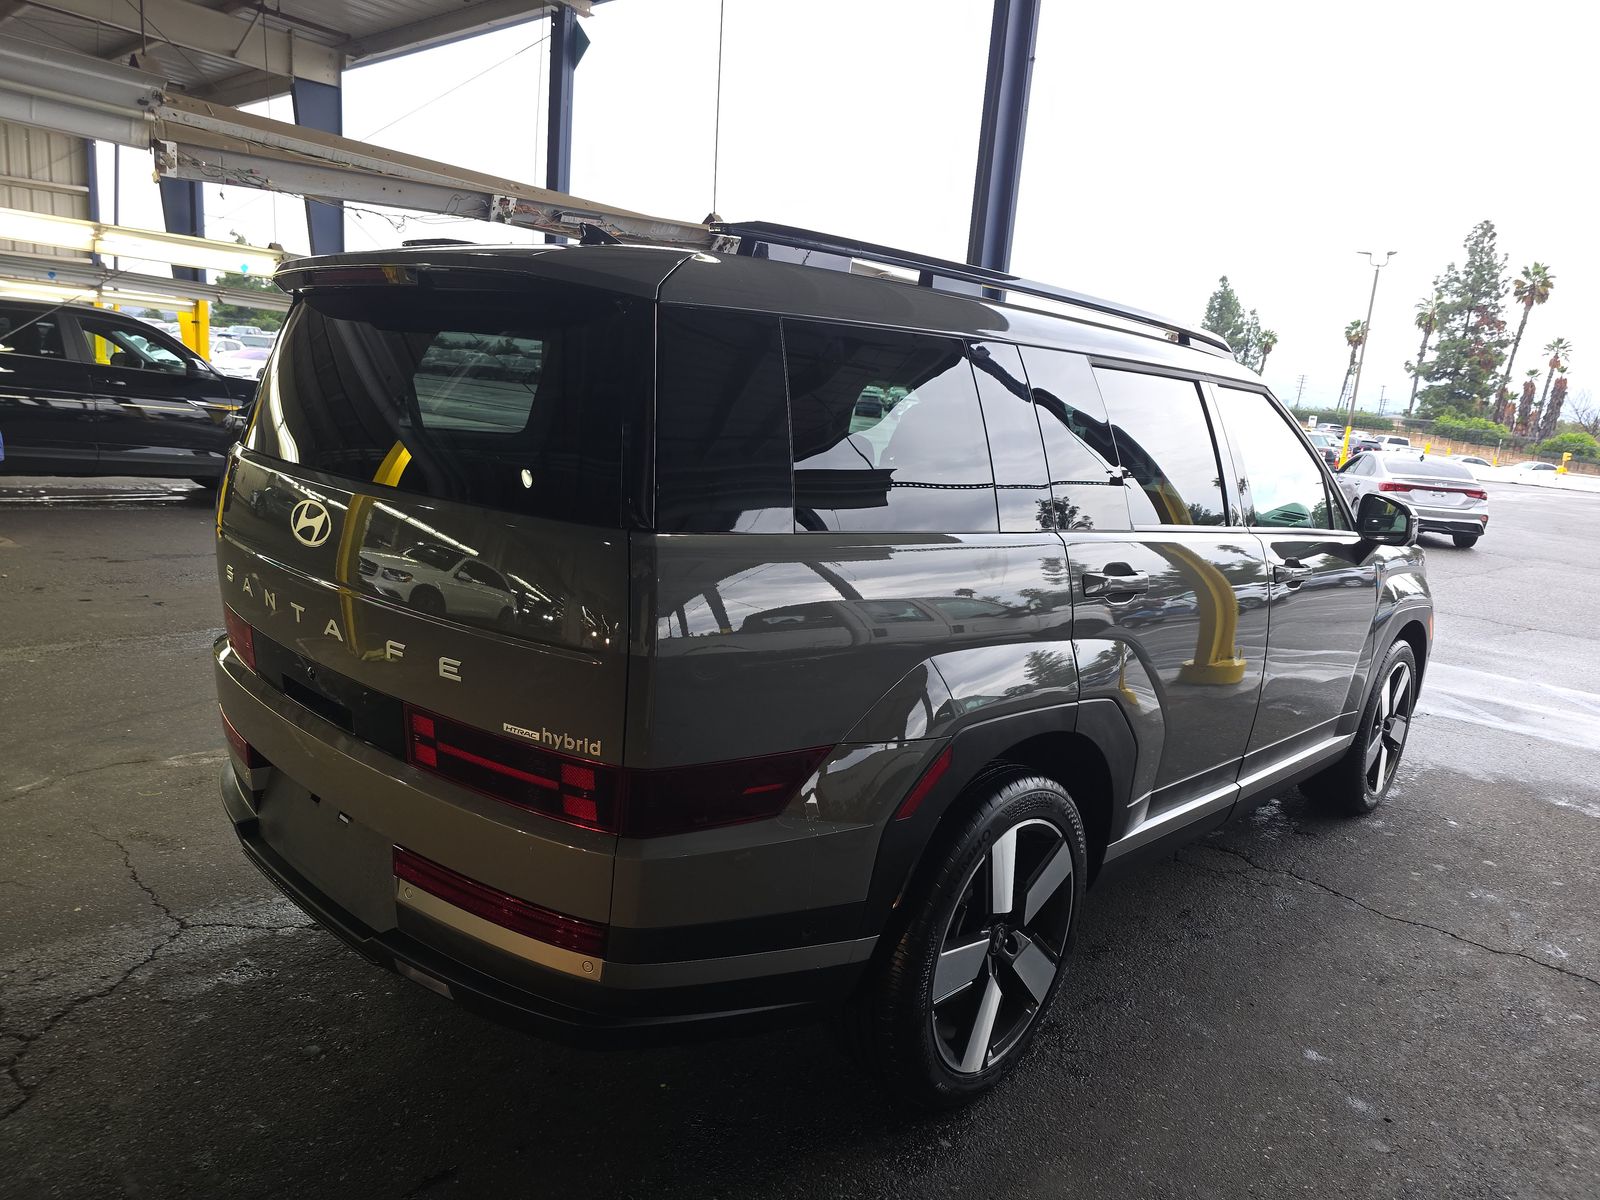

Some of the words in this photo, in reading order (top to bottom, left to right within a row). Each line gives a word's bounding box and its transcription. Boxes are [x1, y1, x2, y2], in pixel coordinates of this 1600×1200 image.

[226, 564, 343, 642] SANTA
[386, 640, 462, 682] FE
[505, 725, 538, 740] HTRAC
[542, 727, 602, 756] hybrid
